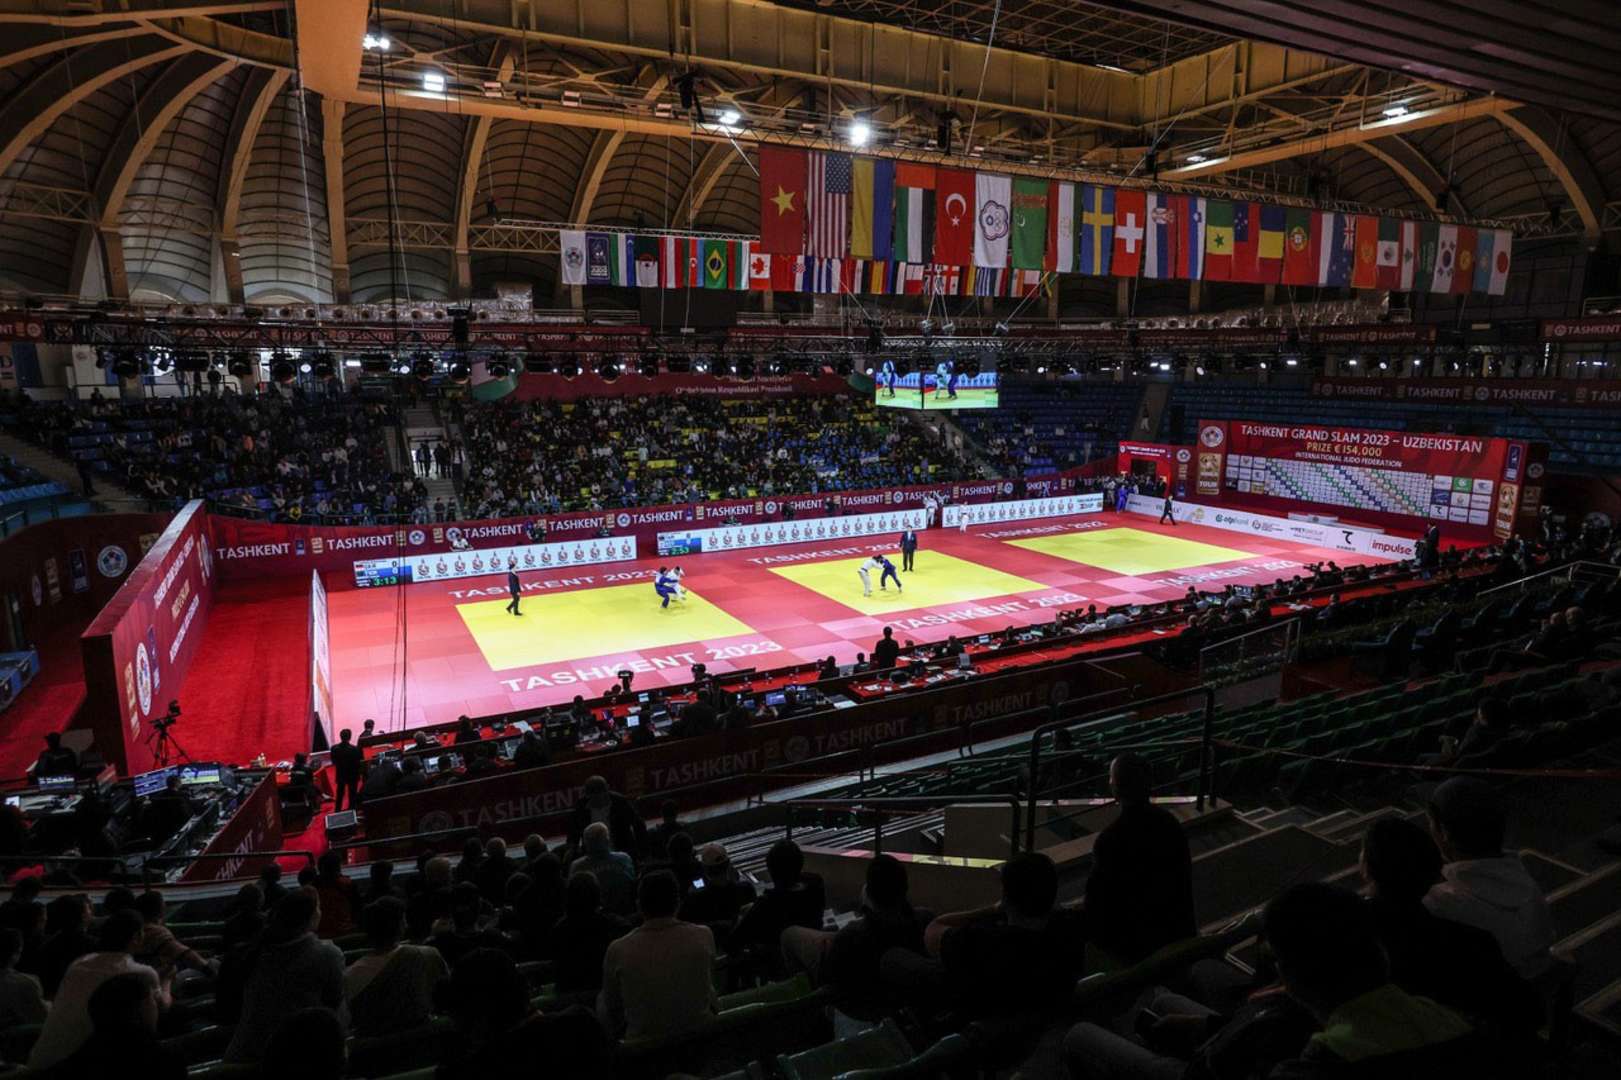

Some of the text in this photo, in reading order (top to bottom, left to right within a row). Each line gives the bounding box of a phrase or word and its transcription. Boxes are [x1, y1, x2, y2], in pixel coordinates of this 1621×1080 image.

[1493, 388, 1557, 401] TASHKENT
[1241, 425, 1290, 438] TASHKENT
[1291, 428, 1329, 441] GRAND
[1331, 431, 1360, 443] SLAM
[1362, 433, 1391, 446] 2023
[1403, 436, 1483, 453] UZBEKISTAN
[1306, 442, 1332, 453] PRIZE
[842, 494, 884, 506] TASHKENT
[632, 509, 684, 525] TASHKENT
[706, 503, 754, 517] TASHKENT
[463, 523, 524, 539] TASHKENT
[549, 517, 606, 532] TASHKENT
[327, 534, 395, 551] TASHKENT
[1371, 539, 1413, 555] impulse
[216, 542, 292, 560] TASHKENT
[449, 576, 593, 598] TASKENT
[888, 602, 1028, 630] TASHKENT
[502, 640, 786, 692] TASHKENT 2023
